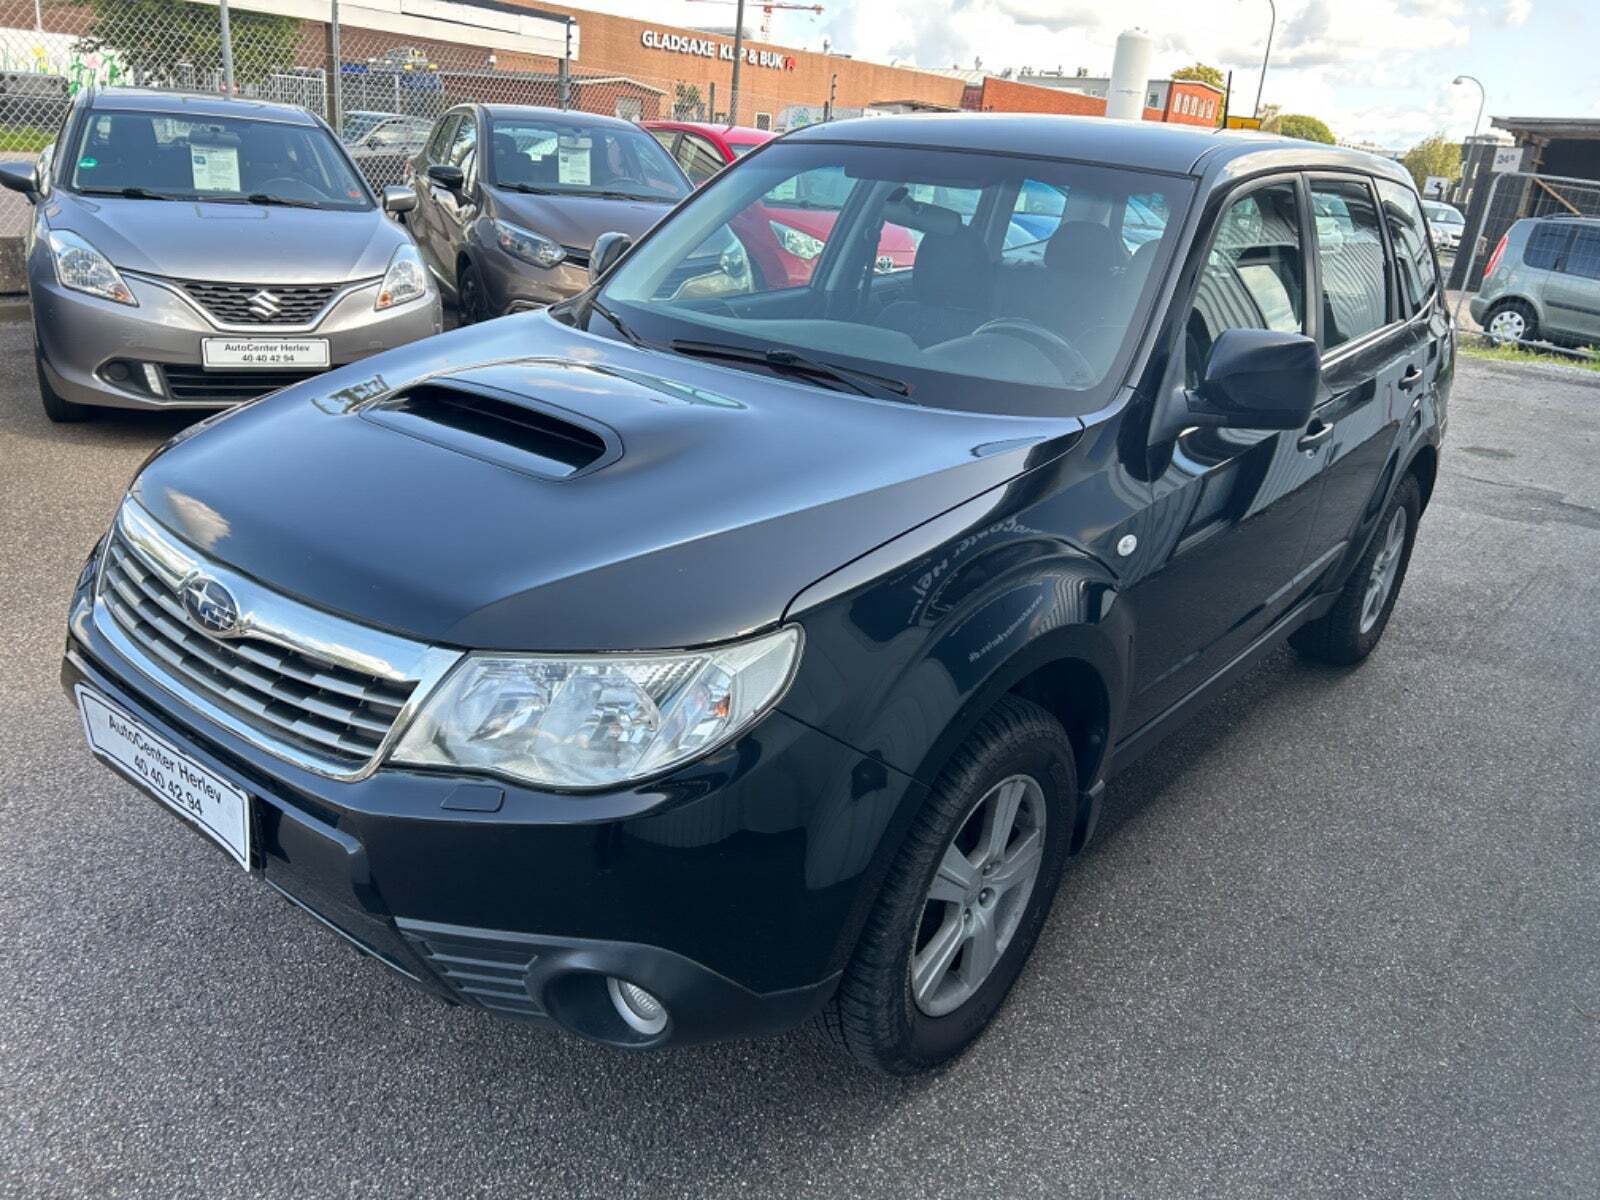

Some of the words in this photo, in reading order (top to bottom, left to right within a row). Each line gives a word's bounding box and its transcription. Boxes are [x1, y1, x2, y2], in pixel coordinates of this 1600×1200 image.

[642, 29, 715, 57] GLADSAXE
[720, 43, 746, 61] KLP
[748, 48, 758, 65] &
[760, 50, 783, 69] BUK
[224, 343, 278, 352] AutoCenter
[280, 343, 310, 352] Herlev
[241, 354, 253, 362] 40
[256, 354, 268, 362] 40
[269, 354, 281, 362] 42
[108, 715, 175, 772] AutoCenter
[178, 761, 222, 805] Herlev
[134, 754, 149, 777] 40
[150, 768, 165, 790] 40
[167, 779, 183, 800] 42
[186, 793, 203, 816] 94
